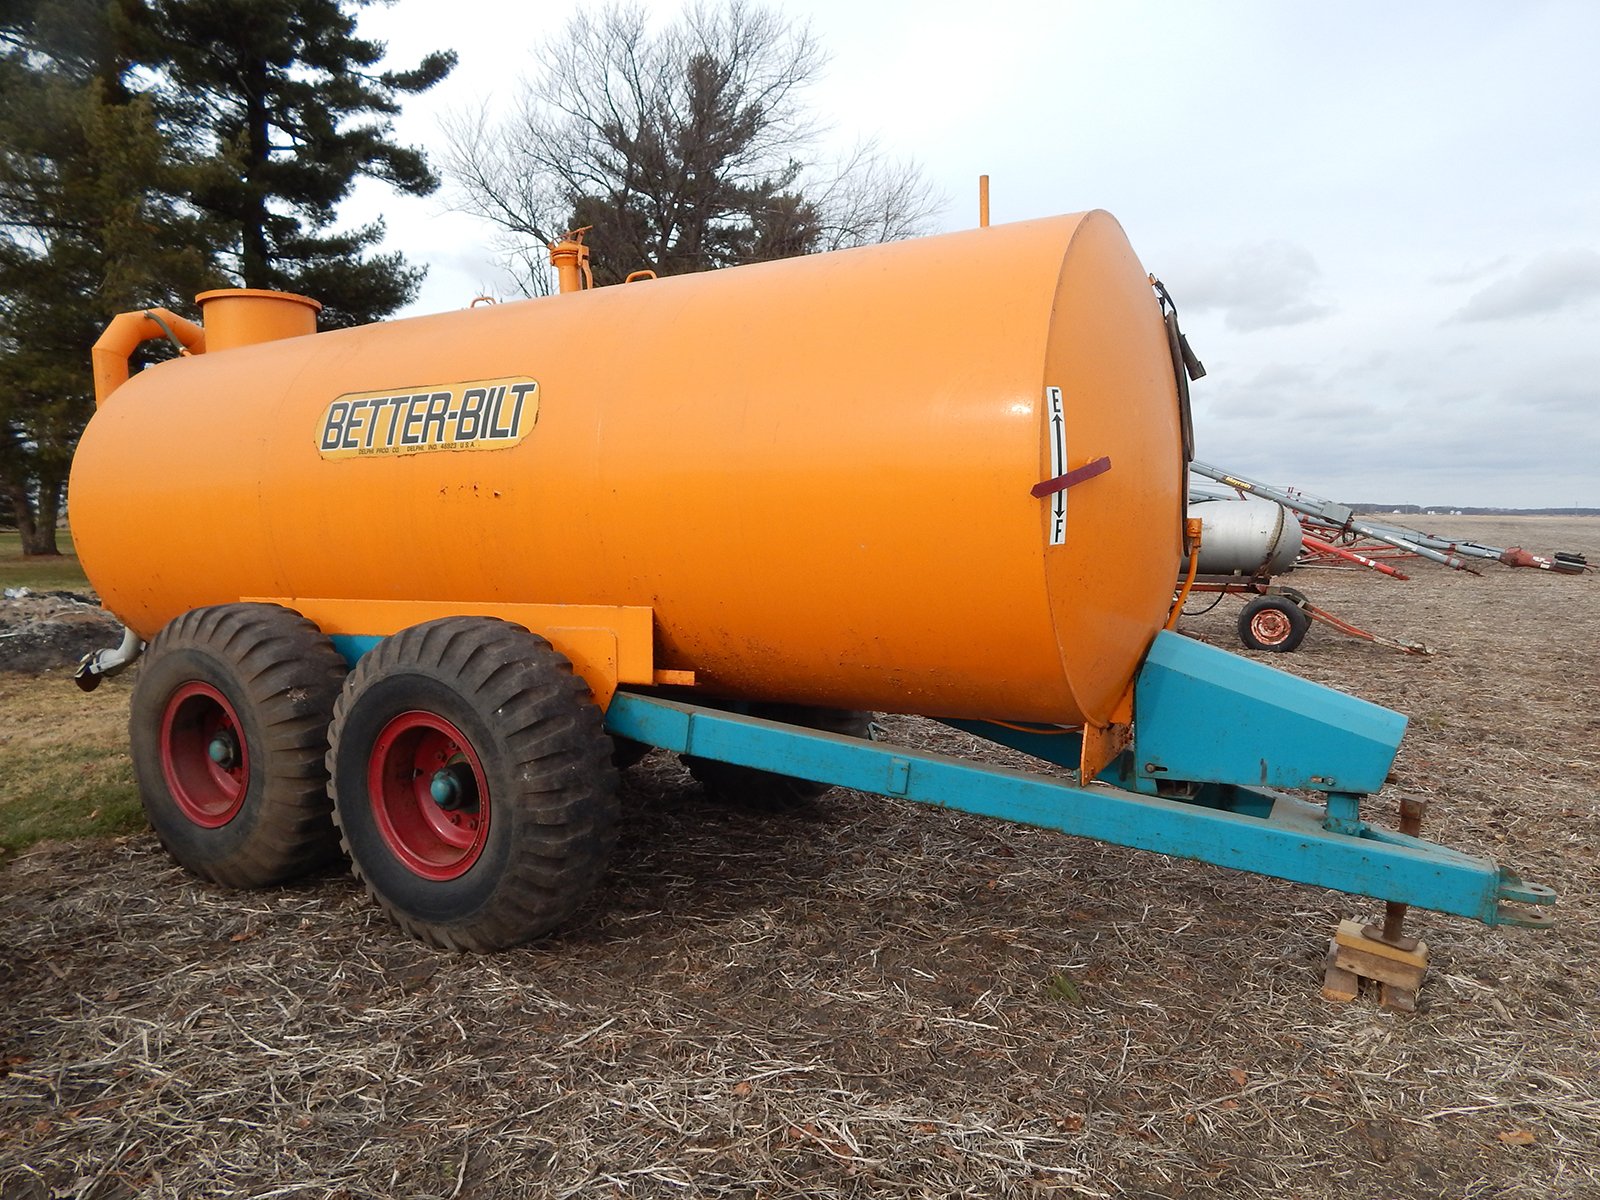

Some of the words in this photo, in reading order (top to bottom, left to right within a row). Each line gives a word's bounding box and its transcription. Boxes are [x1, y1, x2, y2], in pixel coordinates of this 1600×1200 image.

[1052, 389, 1061, 413] E
[320, 382, 536, 450] BETTER-BILT
[1055, 519, 1063, 543] F
